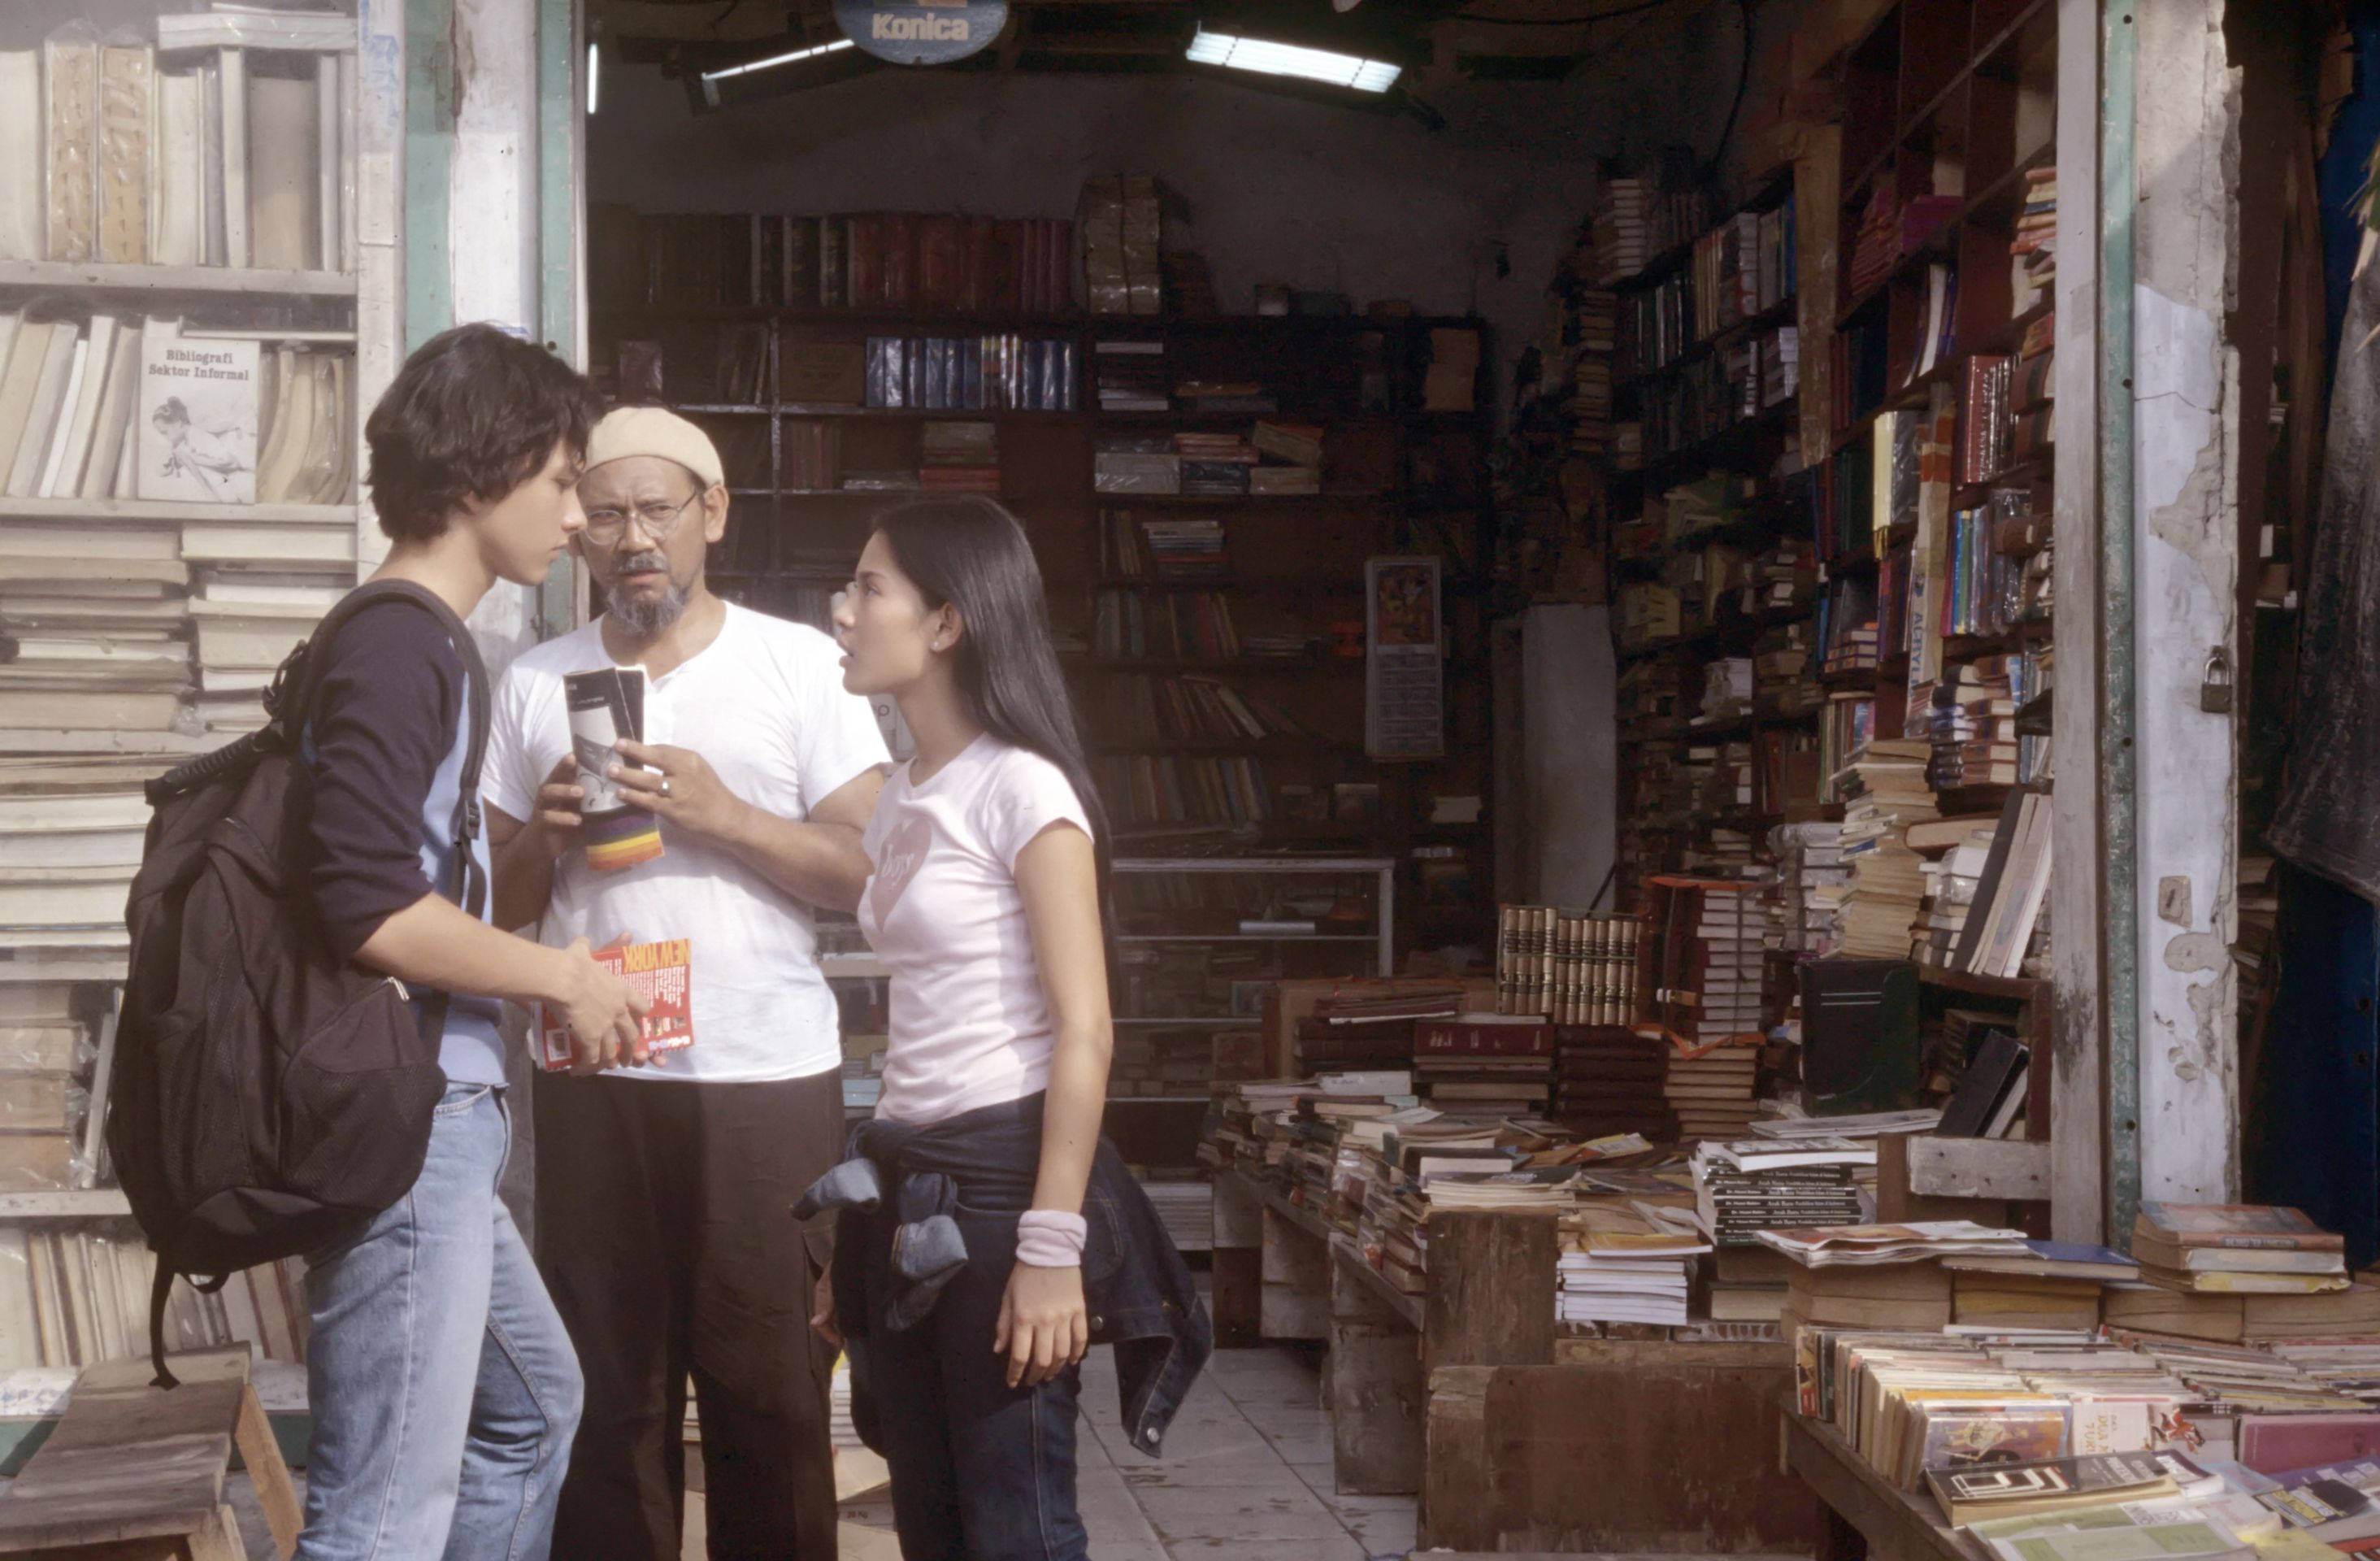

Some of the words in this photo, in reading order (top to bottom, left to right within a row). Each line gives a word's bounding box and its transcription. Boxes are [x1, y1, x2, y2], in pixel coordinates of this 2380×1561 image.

[872, 12, 969, 41] Konica
[165, 349, 233, 365] Bibliografi
[148, 363, 191, 377] Sektor
[193, 367, 250, 380] Informal
[623, 943, 661, 973] YORK
[660, 939, 690, 967] NEW
